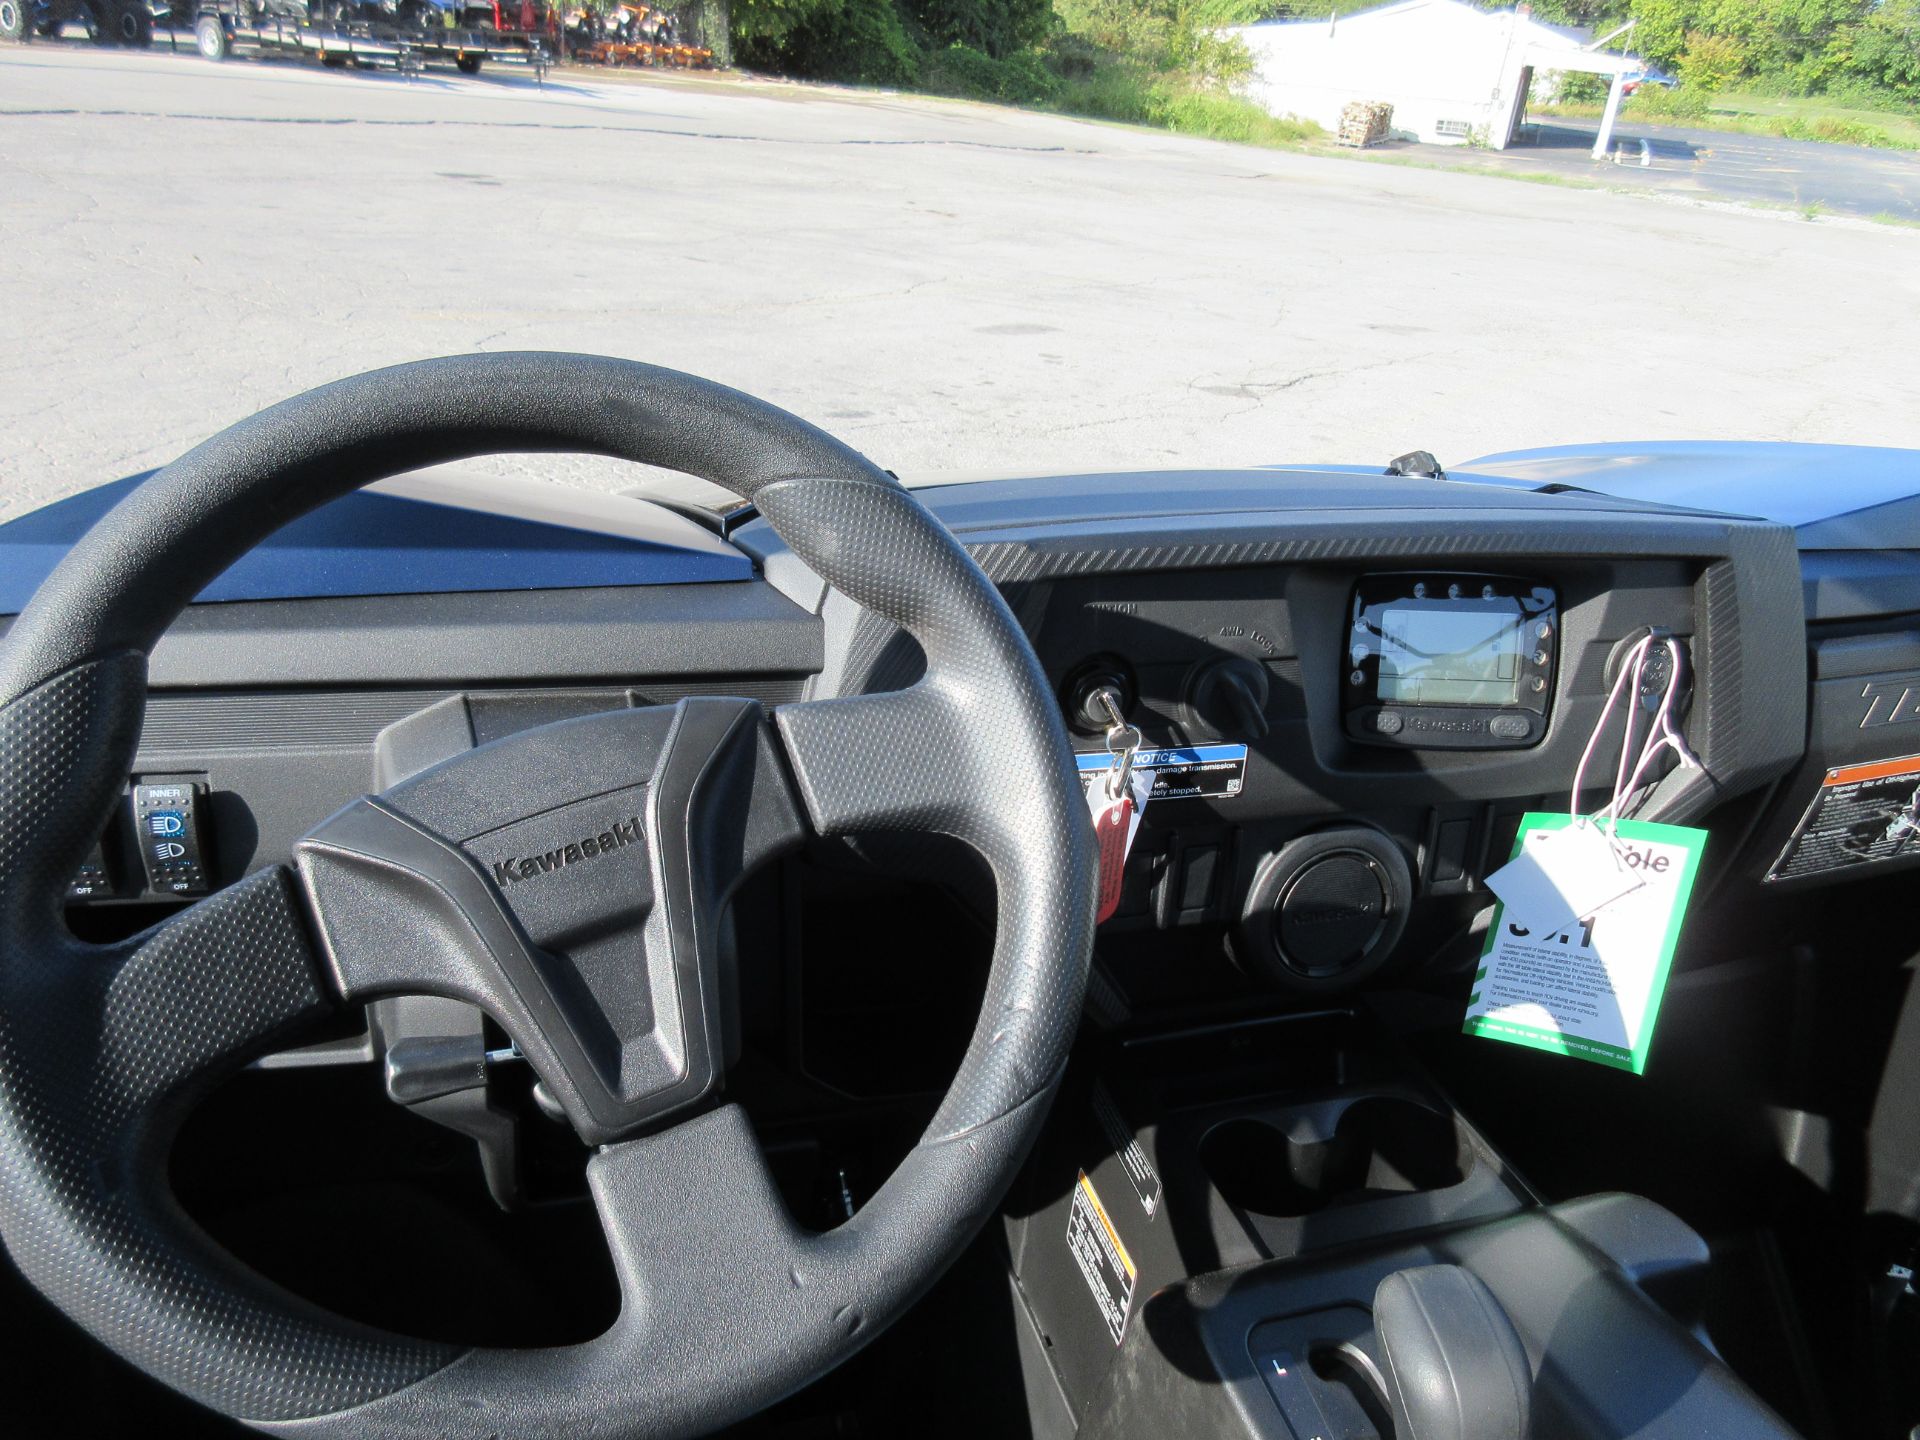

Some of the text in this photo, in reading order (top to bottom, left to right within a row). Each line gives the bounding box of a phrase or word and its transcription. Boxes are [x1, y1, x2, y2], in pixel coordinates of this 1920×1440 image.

[1133, 752, 1177, 764] NOTICE
[1156, 767, 1188, 775] damage
[1189, 763, 1238, 772] transmission.
[150, 788, 181, 798] INNER
[1169, 786, 1202, 794] stopped.
[493, 817, 646, 889] Kawasaki
[1623, 844, 1670, 873] ble
[76, 887, 93, 895] OFF
[1560, 1040, 1589, 1051] REMOVED
[1590, 1048, 1614, 1058] BEFORE
